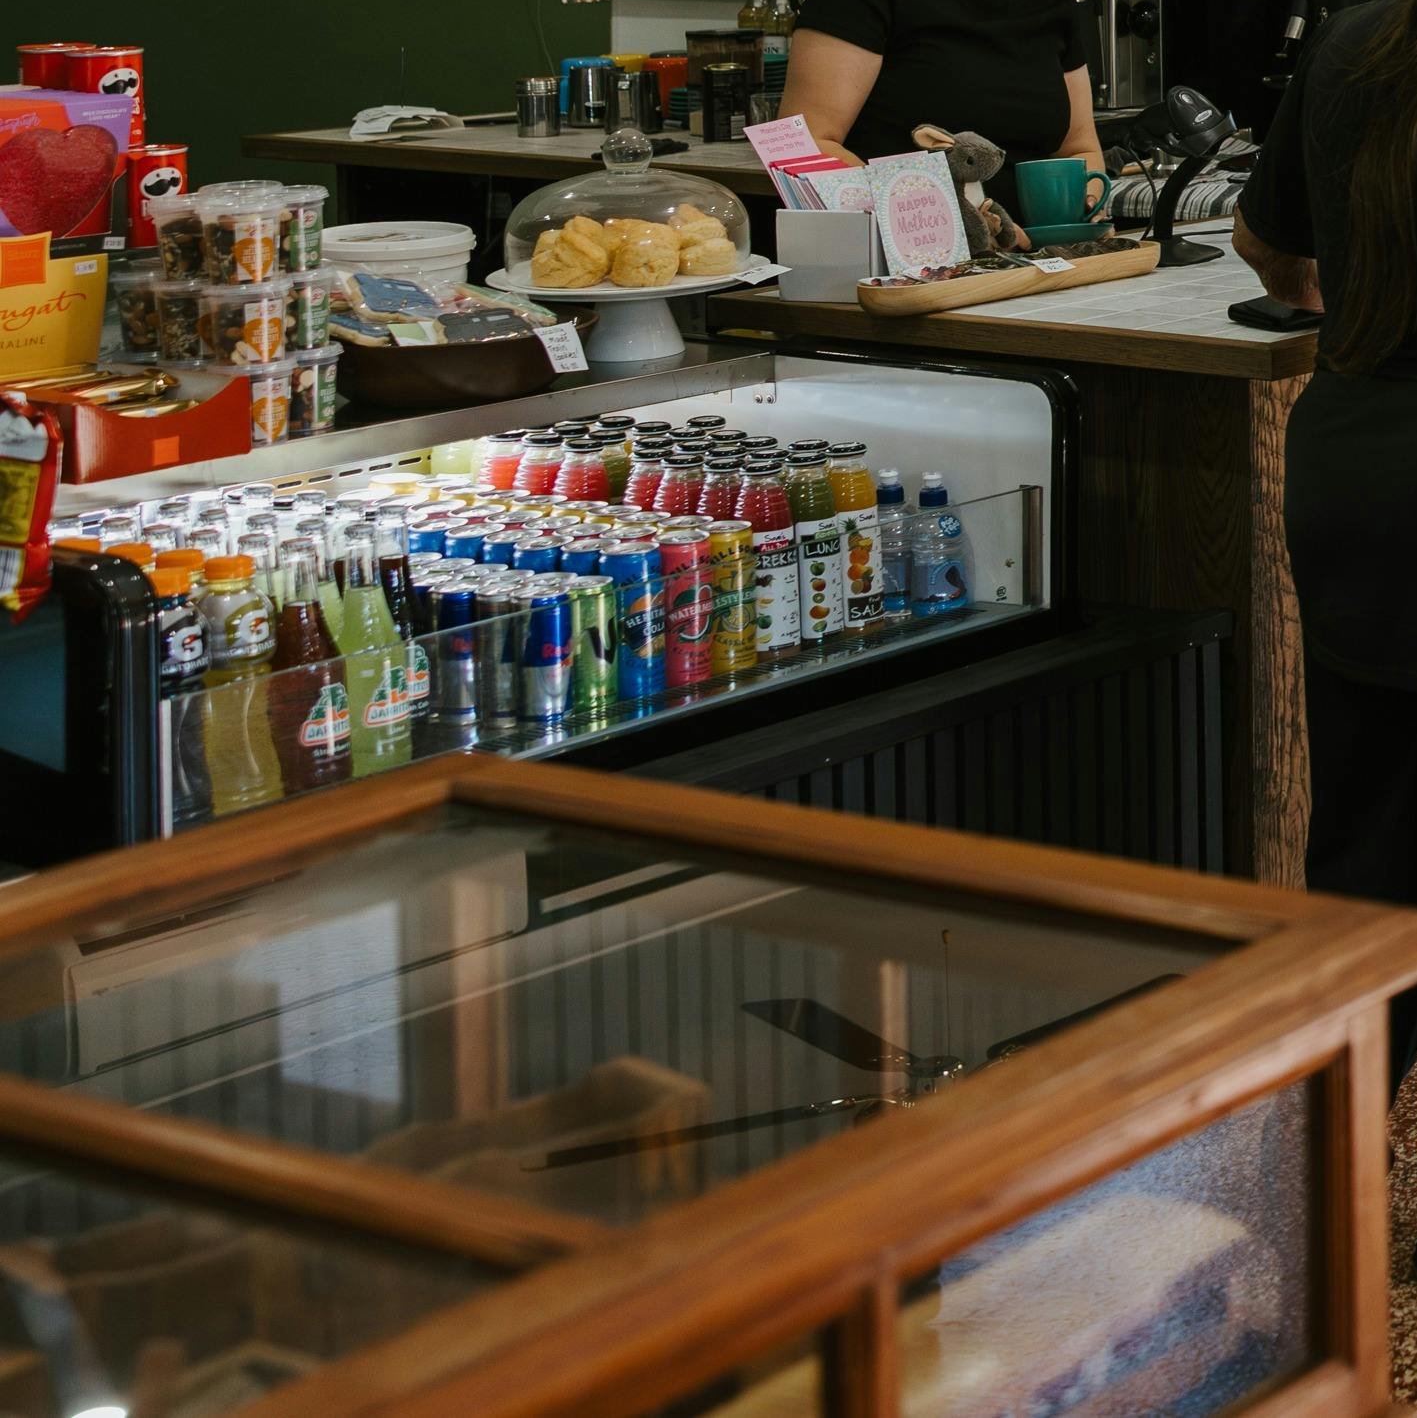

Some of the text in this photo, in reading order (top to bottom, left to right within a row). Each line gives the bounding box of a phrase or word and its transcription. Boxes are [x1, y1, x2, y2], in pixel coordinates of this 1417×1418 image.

[897, 195, 936, 213] HAPPY
[897, 211, 948, 235] Mother's
[913, 233, 937, 247] DAY
[240, 608, 270, 643] G
[169, 625, 202, 662] G
